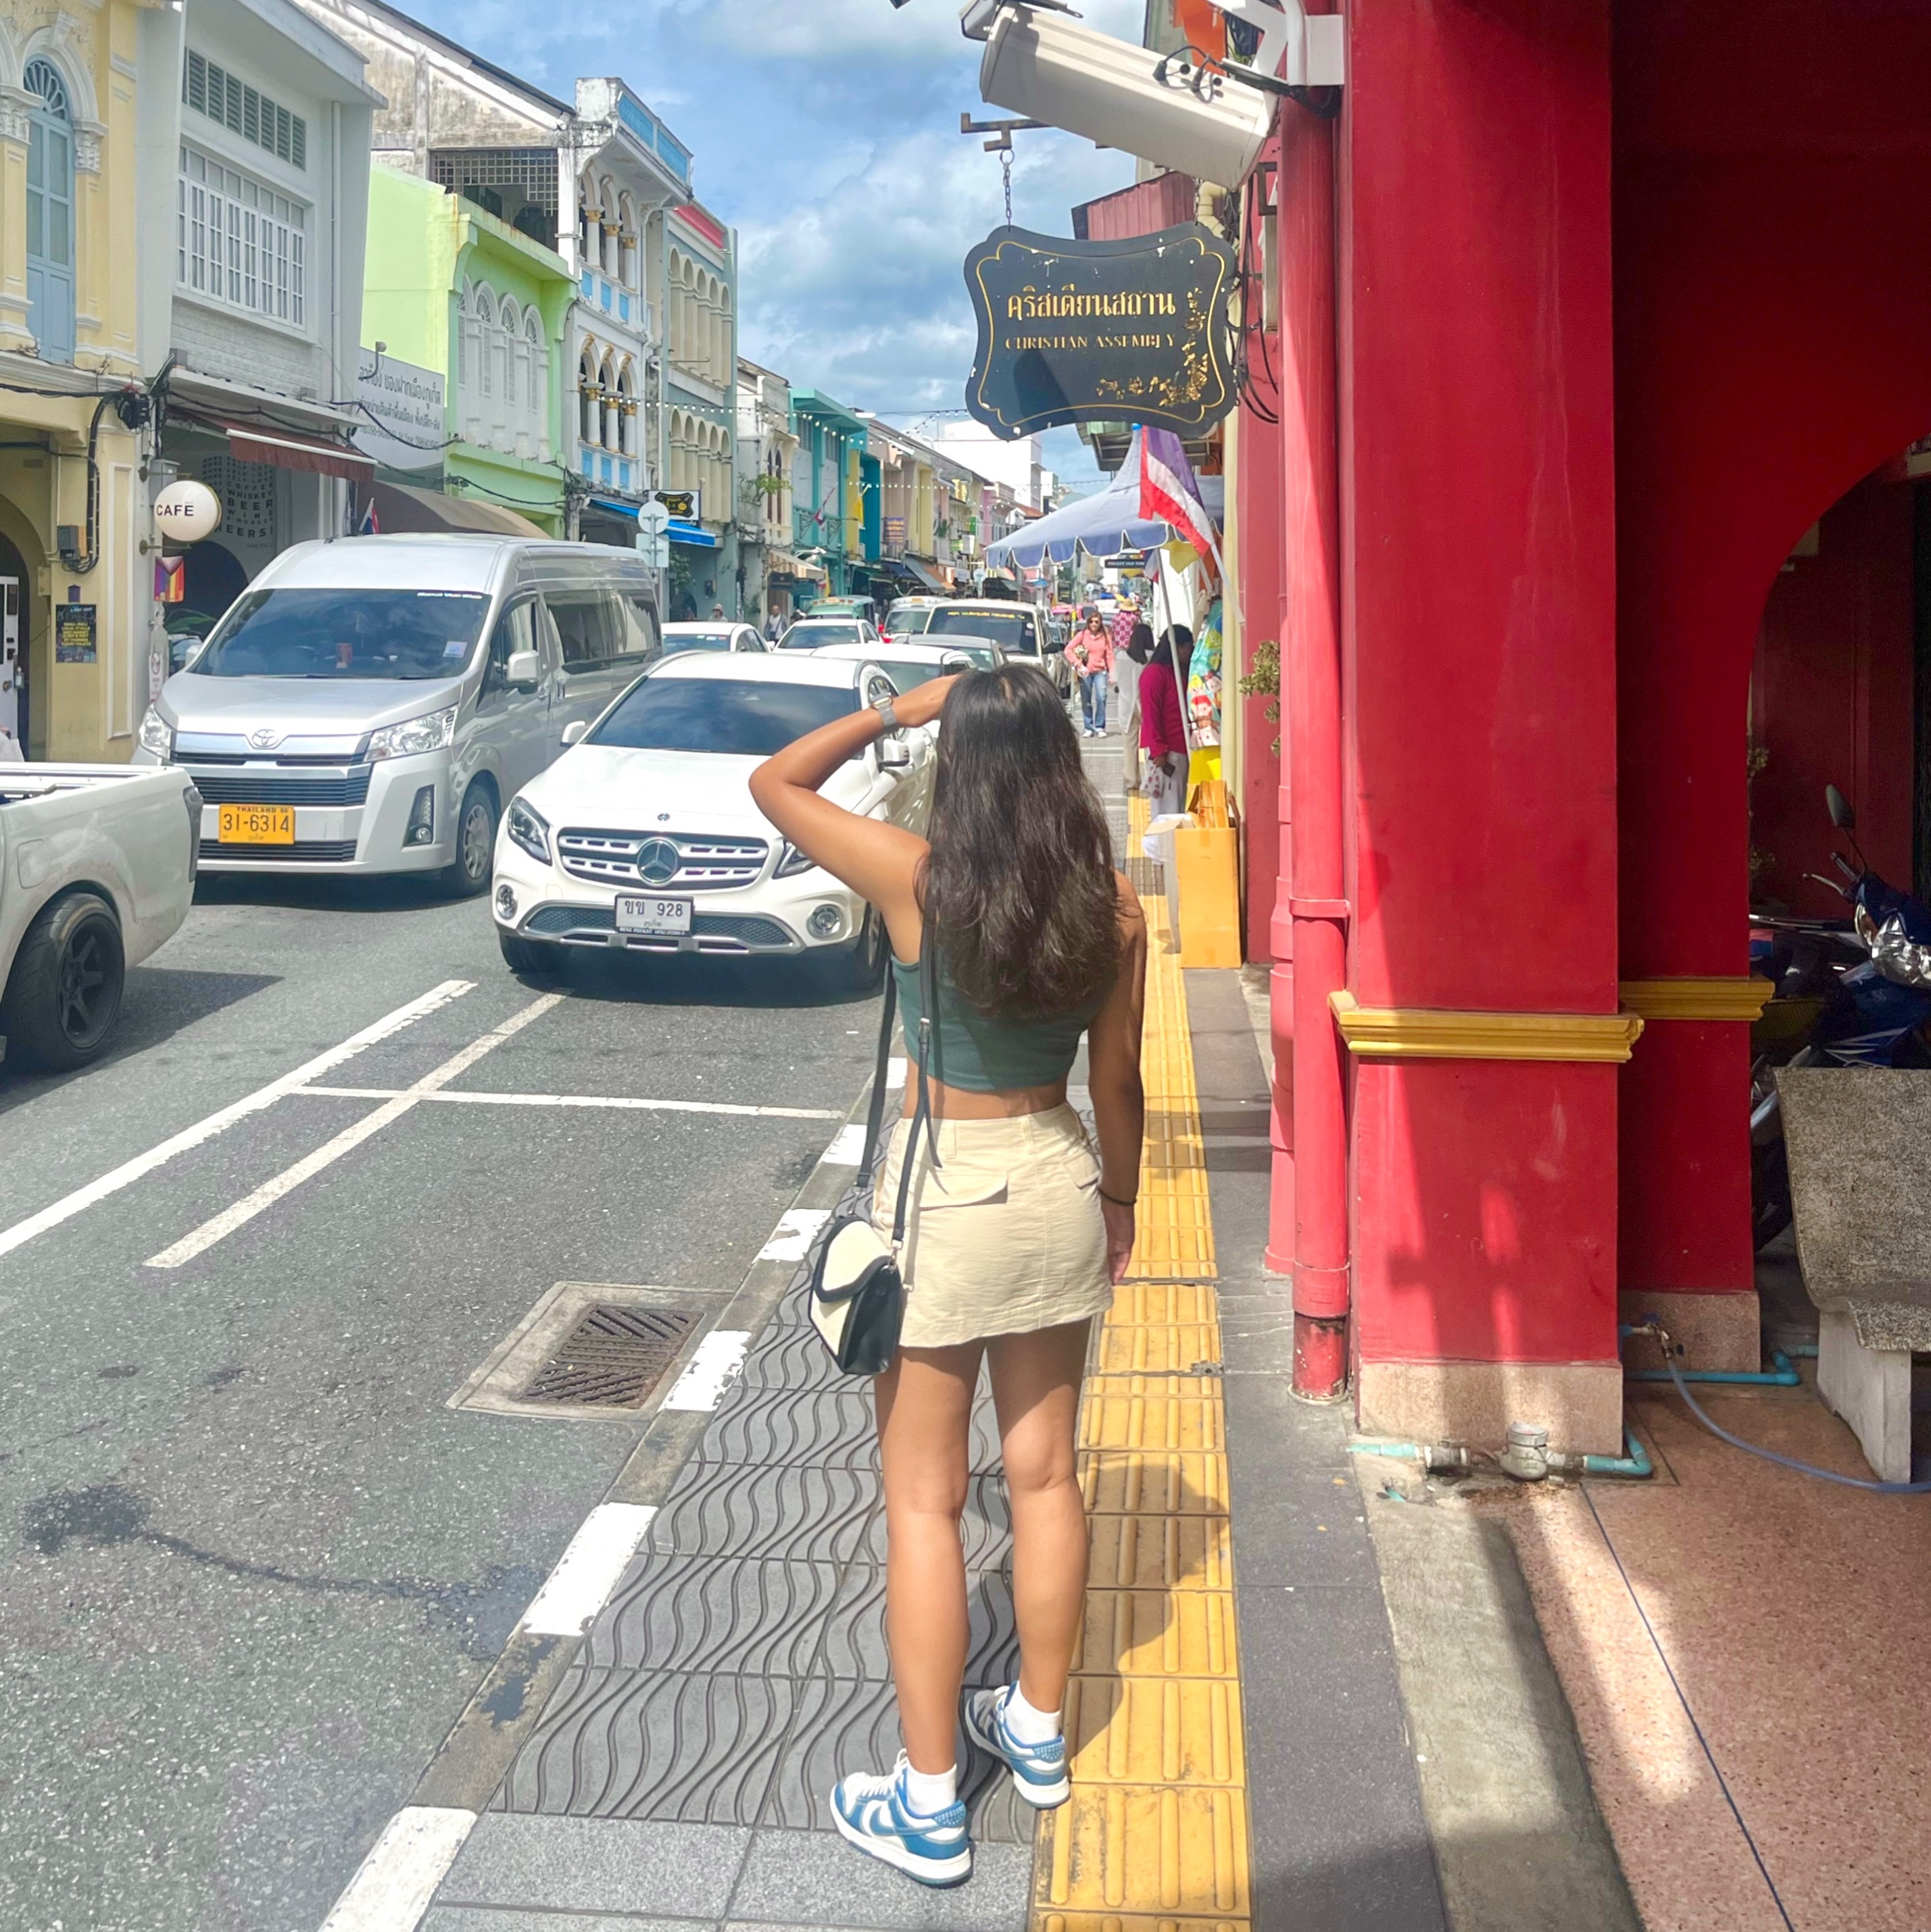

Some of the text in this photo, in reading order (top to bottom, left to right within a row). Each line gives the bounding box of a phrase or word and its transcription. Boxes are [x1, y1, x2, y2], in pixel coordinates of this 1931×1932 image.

[1007, 283, 1176, 321] คริสเตียนสถาน
[156, 504, 194, 516] CAFE
[227, 497, 273, 511] BEER
[214, 524, 273, 539] HEERS!
[223, 813, 289, 833] 31-6314
[657, 902, 683, 917] 928
